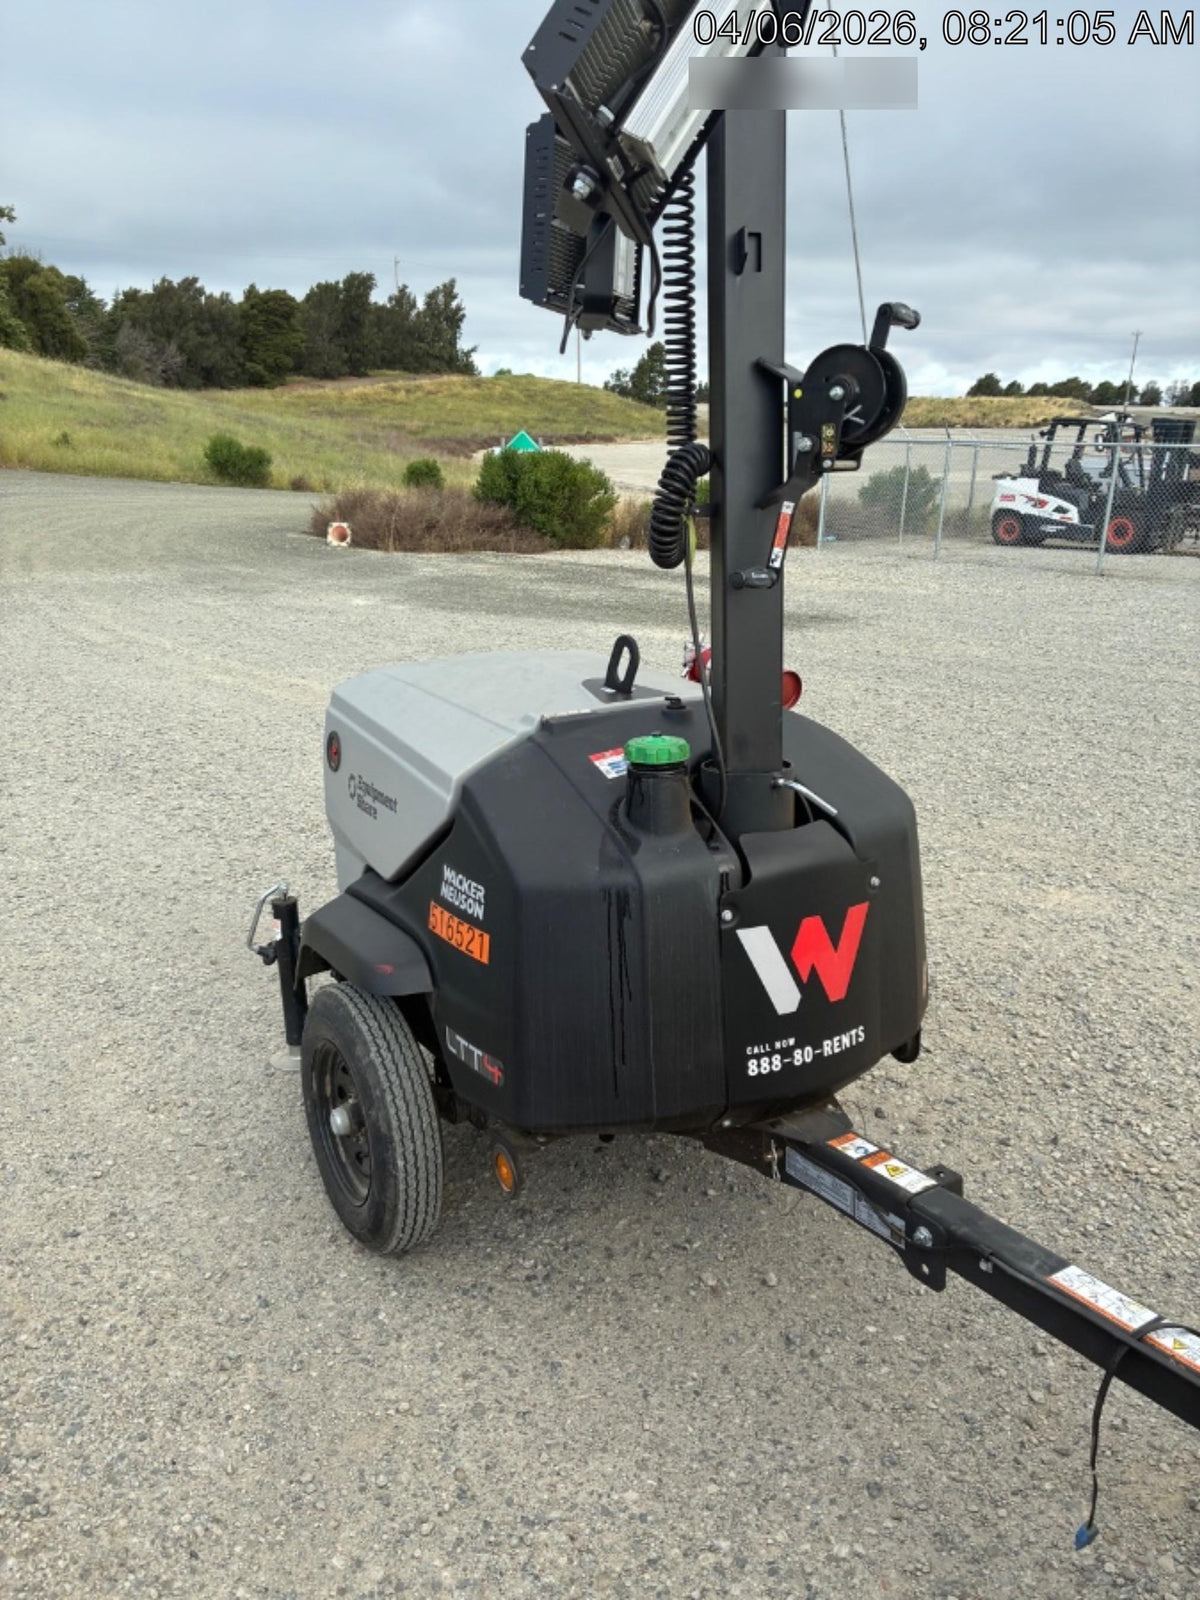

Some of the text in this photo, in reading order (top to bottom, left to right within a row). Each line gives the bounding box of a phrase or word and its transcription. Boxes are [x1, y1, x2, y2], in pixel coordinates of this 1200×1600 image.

[440, 881, 485, 921] NEUSON
[443, 864, 486, 903] WACKER
[430, 904, 486, 960] 516521
[445, 1025, 503, 1086] LTT4
[746, 1036, 796, 1055] CALL NOW
[747, 1024, 866, 1077] 888-80-RENTS
